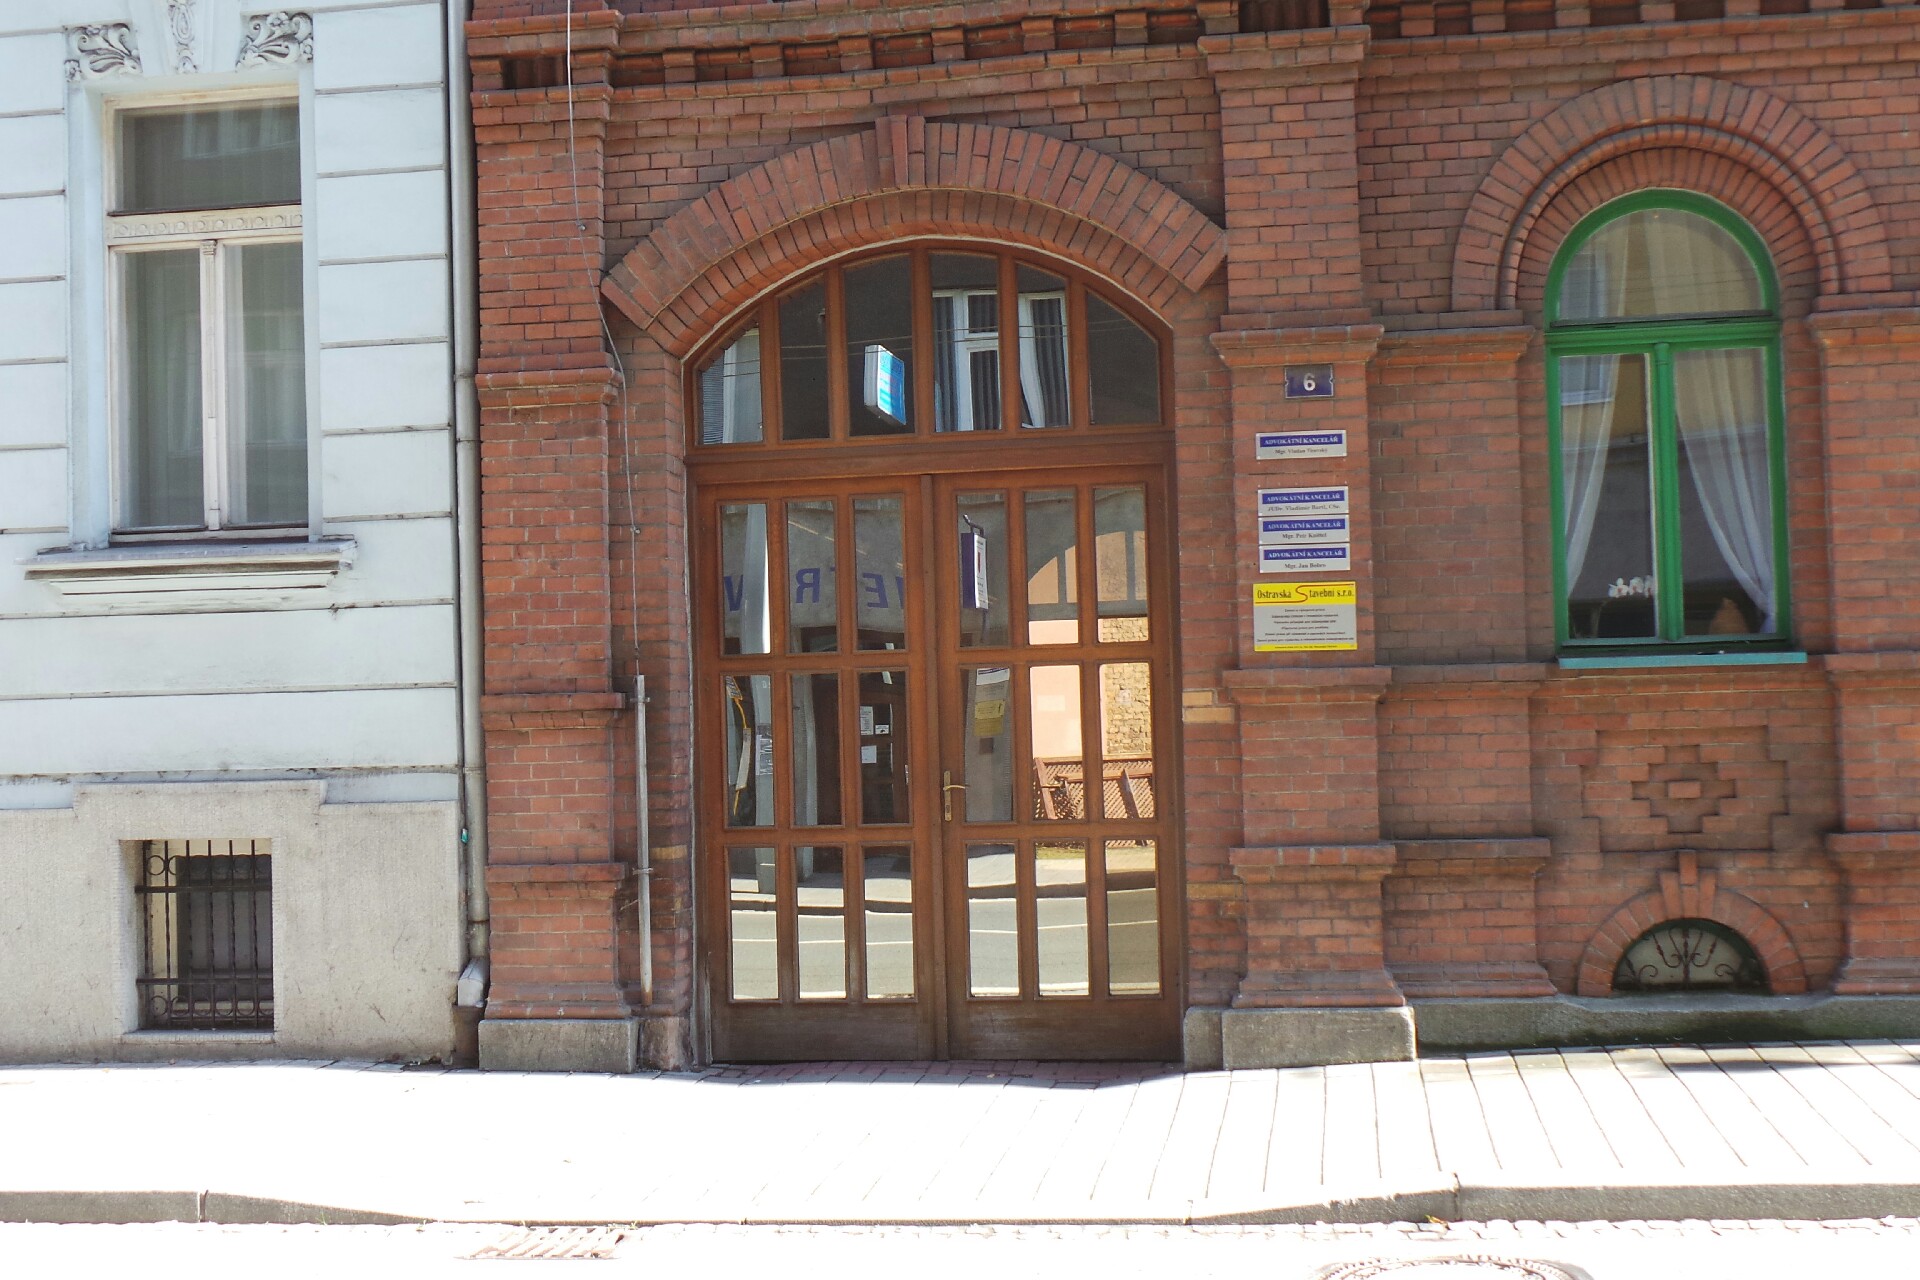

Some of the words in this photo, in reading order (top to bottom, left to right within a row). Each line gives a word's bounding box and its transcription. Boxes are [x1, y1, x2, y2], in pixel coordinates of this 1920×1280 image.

[1303, 372, 1316, 391] 6
[1303, 435, 1339, 443] KANCELÁŘ
[1304, 492, 1340, 500] KANCELÁŘ
[1305, 520, 1341, 528] KANCELÁŘ
[1307, 549, 1343, 557] KANCELÁŘ
